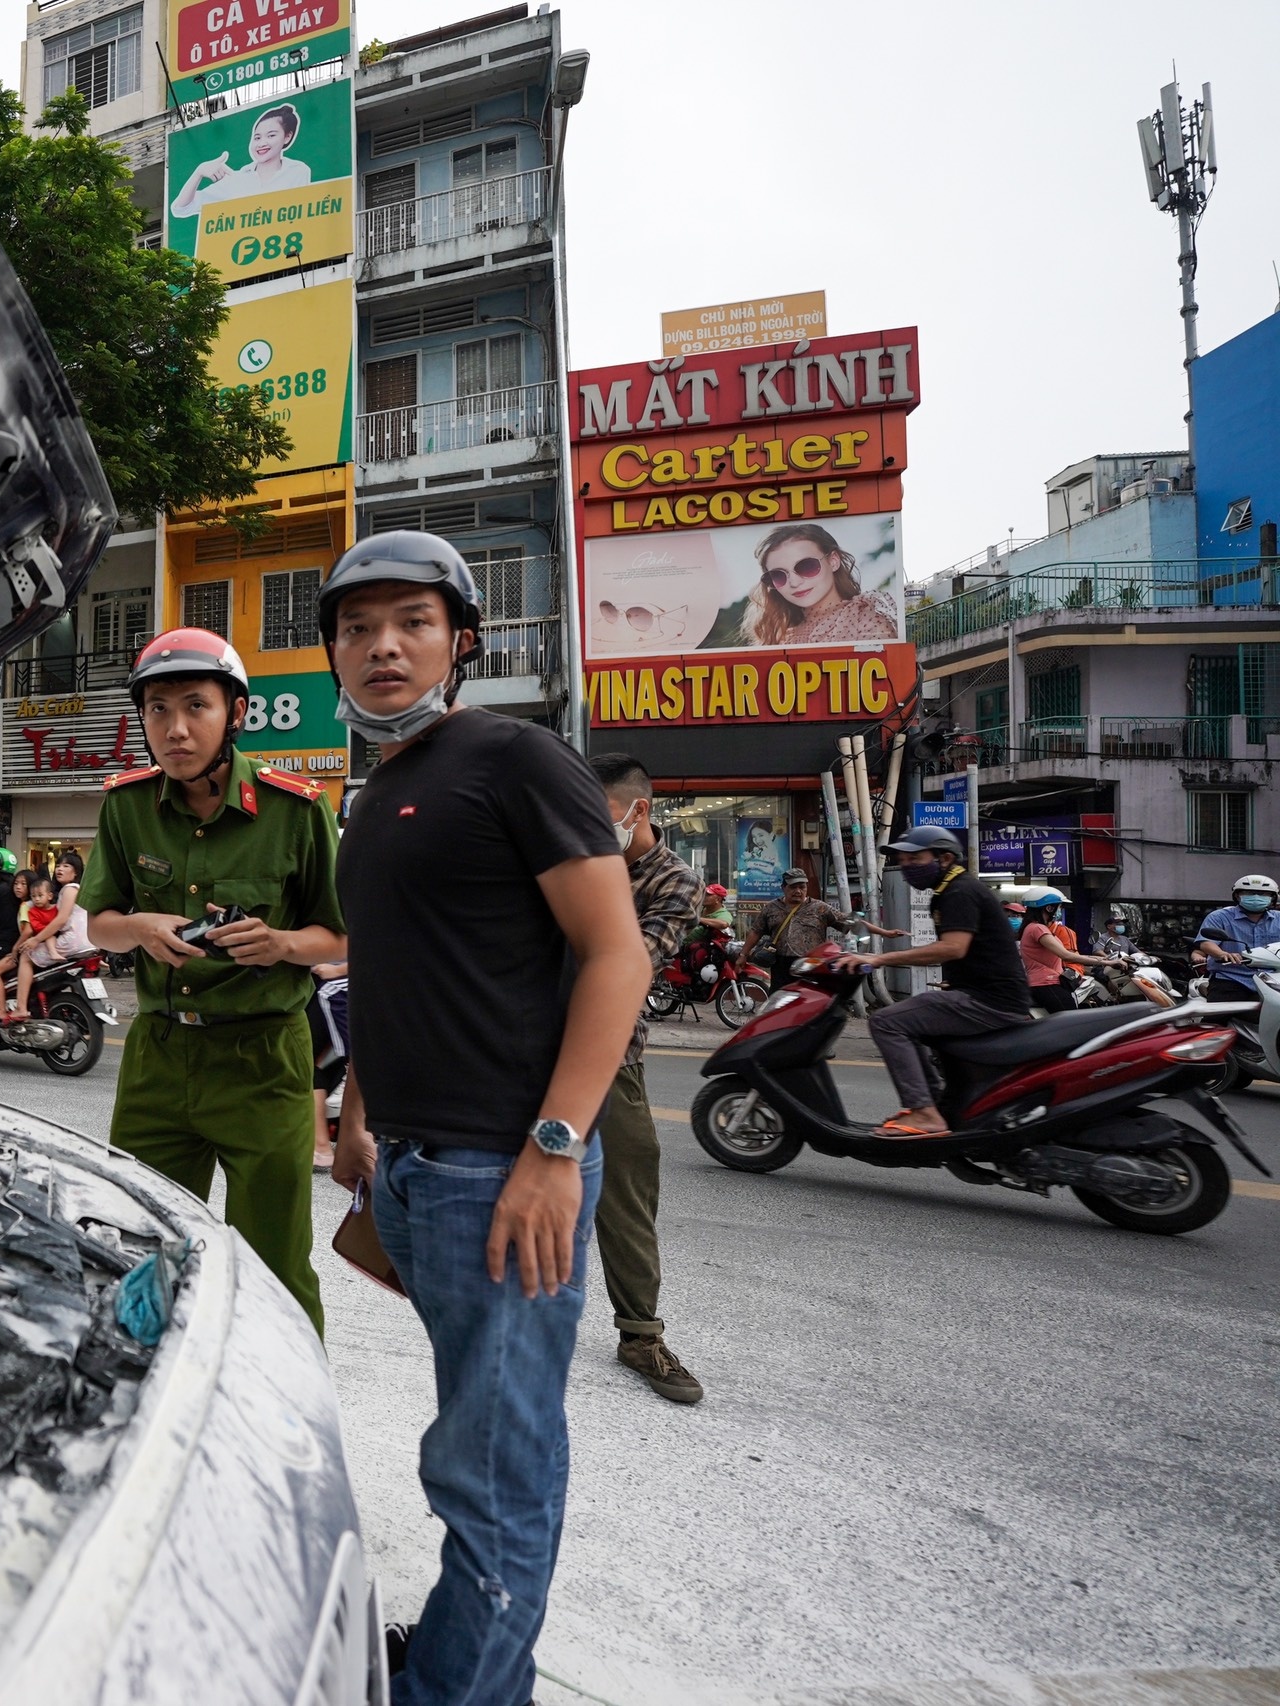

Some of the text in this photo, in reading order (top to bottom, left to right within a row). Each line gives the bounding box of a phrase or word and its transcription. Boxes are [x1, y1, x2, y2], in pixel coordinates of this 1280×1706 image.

[190, 6, 324, 63] Ô TÔ, XE MÁY
[226, 61, 265, 84] 1800
[205, 194, 342, 235] CẦN TIỀN GỌI LIỀN
[696, 321, 757, 340] BILLBOARD
[760, 315, 794, 331] NGOÀI
[797, 310, 824, 326] TRỜI
[700, 299, 784, 325] CHỦ NHÀ MỜI
[680, 327, 808, 354] 09.0246.1998
[260, 368, 326, 403] 6388
[579, 338, 915, 438] MẮT KÍNH
[601, 430, 870, 491] Cartier
[611, 480, 849, 531] LACOSTE
[582, 657, 888, 721] VINASTAR OPTIC
[16, 692, 85, 718] Áo Cưới
[268, 754, 303, 771] TOÀN
[308, 750, 344, 771] QUỐC
[919, 815, 959, 827] HOÀNG DIỆU
[924, 804, 955, 813] ĐƯỜNG
[980, 842, 1009, 852] Express
[1038, 866, 1062, 874] 20K
